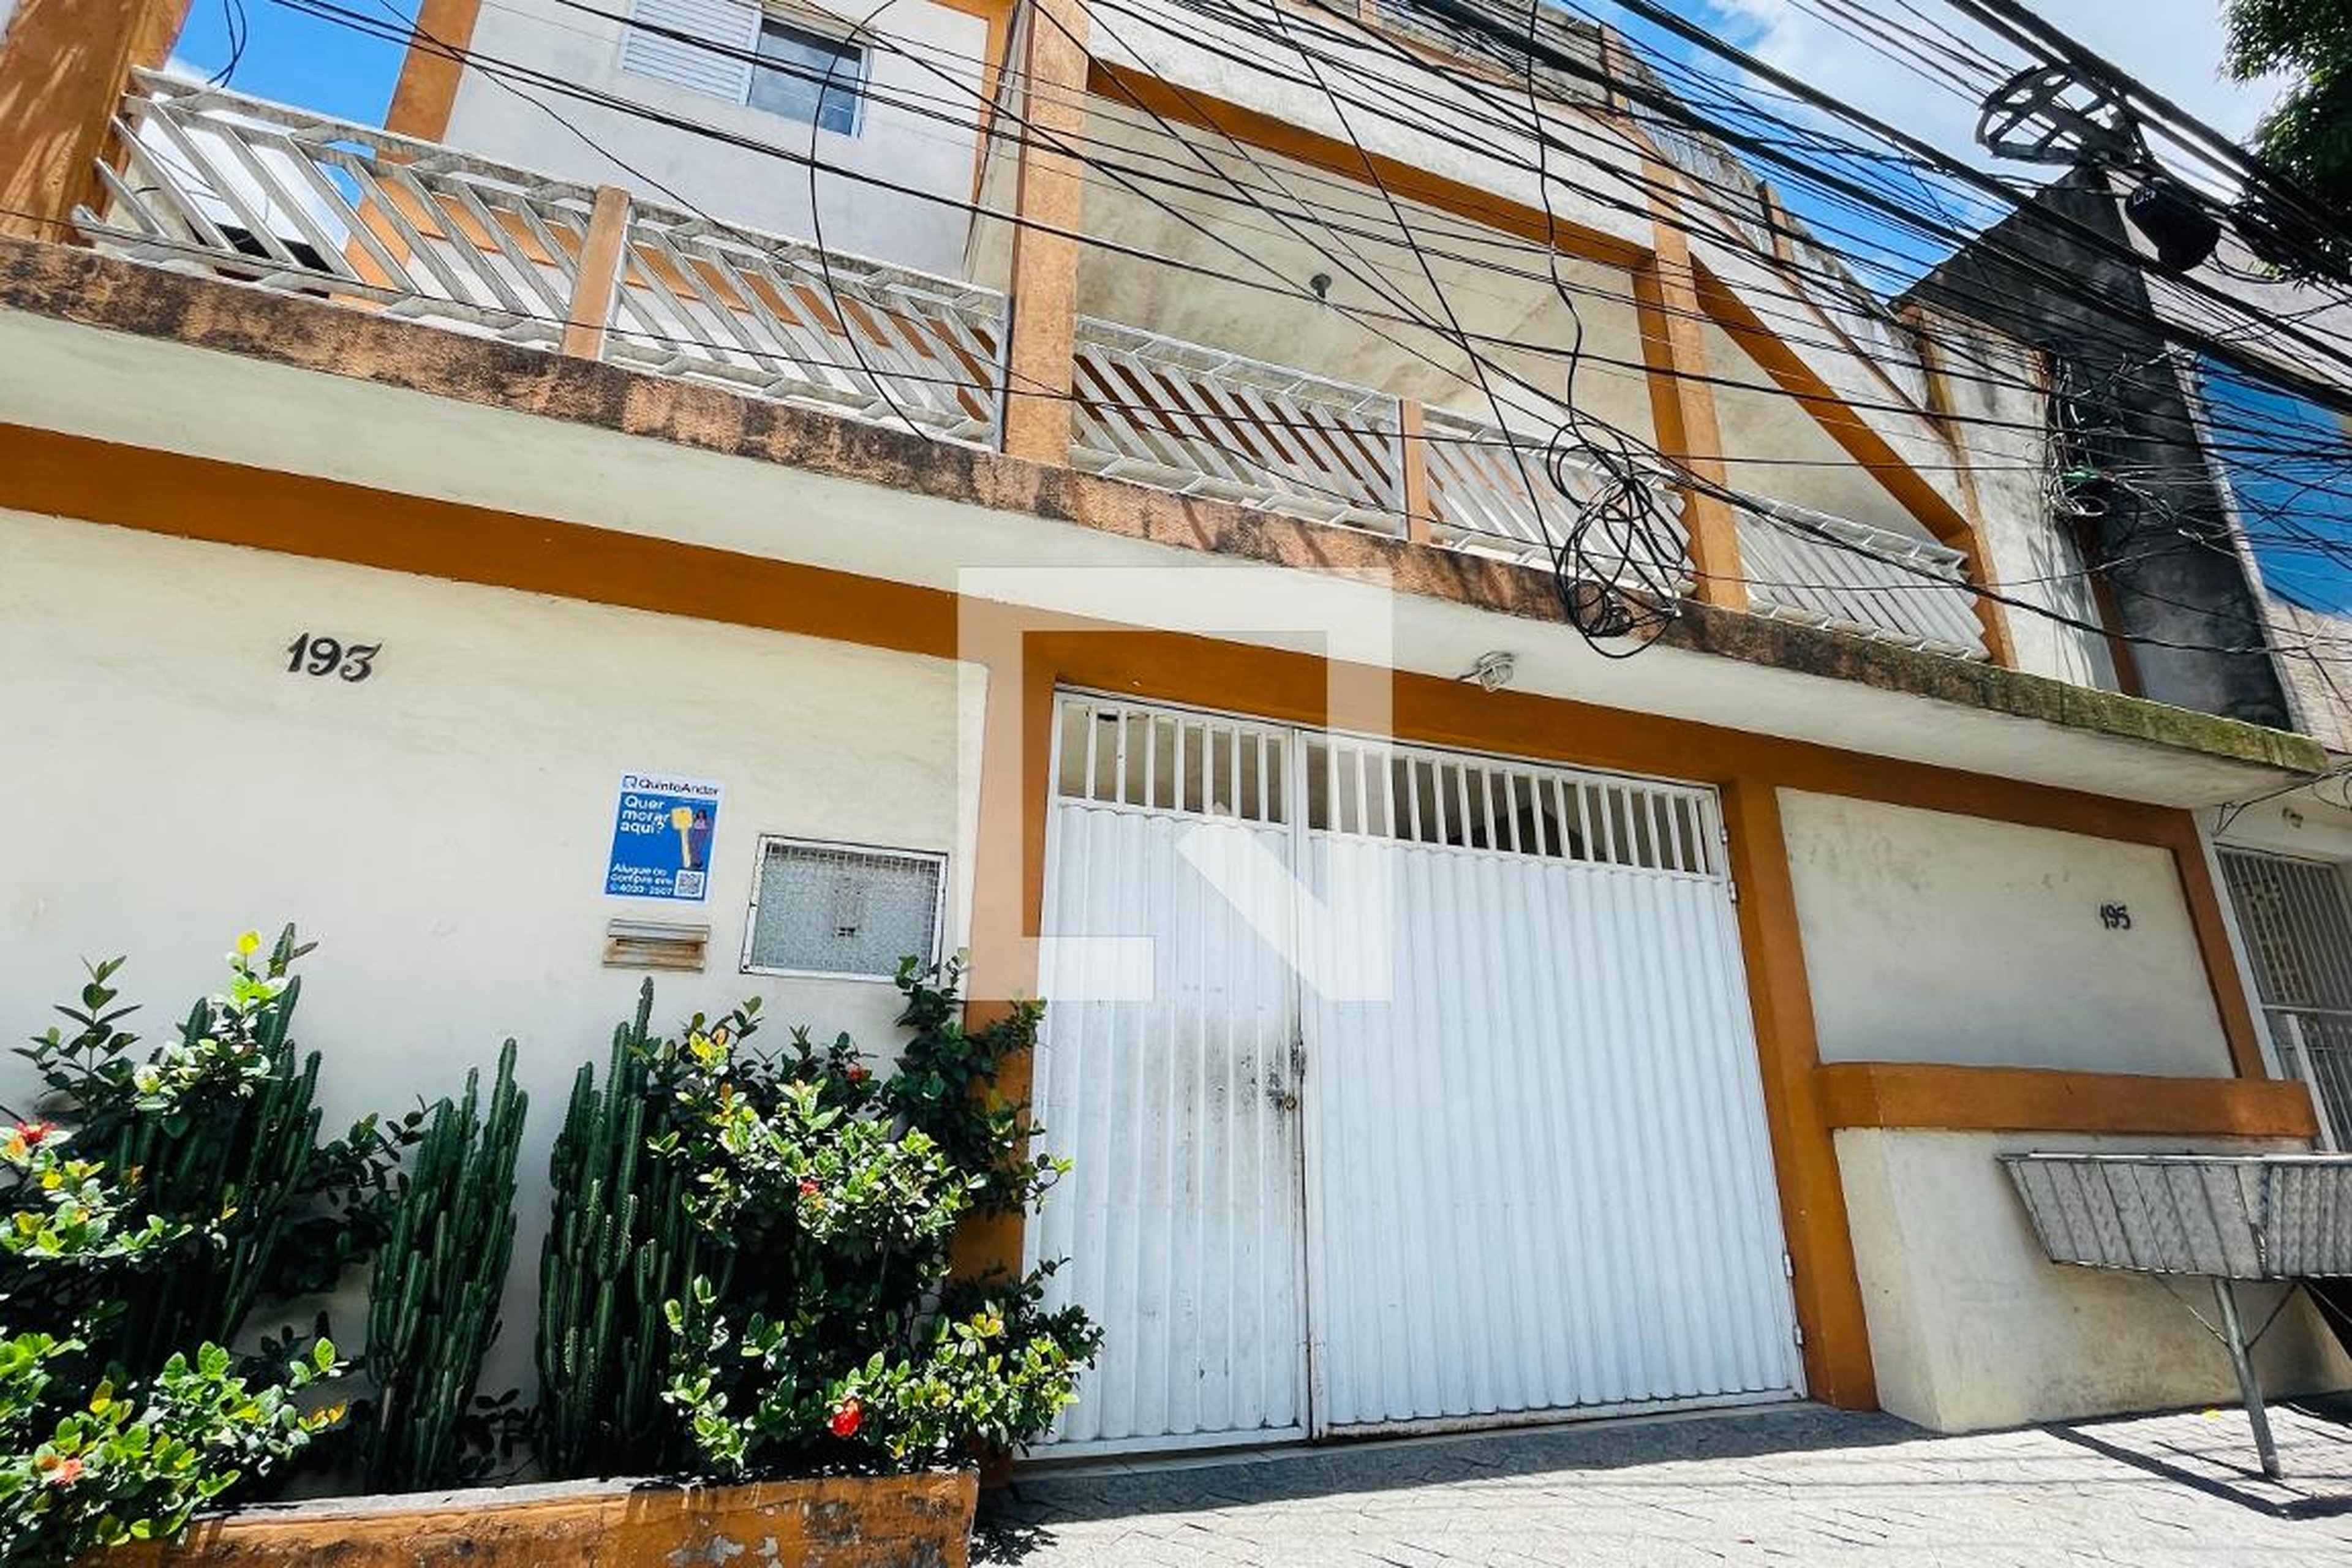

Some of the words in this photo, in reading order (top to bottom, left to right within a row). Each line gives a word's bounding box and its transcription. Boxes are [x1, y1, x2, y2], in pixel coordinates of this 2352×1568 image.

[287, 632, 383, 682] 193
[639, 778, 719, 796] QuintoAndar
[624, 795, 666, 810] Quer
[622, 809, 671, 823] morar
[620, 820, 665, 835] aqui?
[2100, 903, 2131, 930] 195
